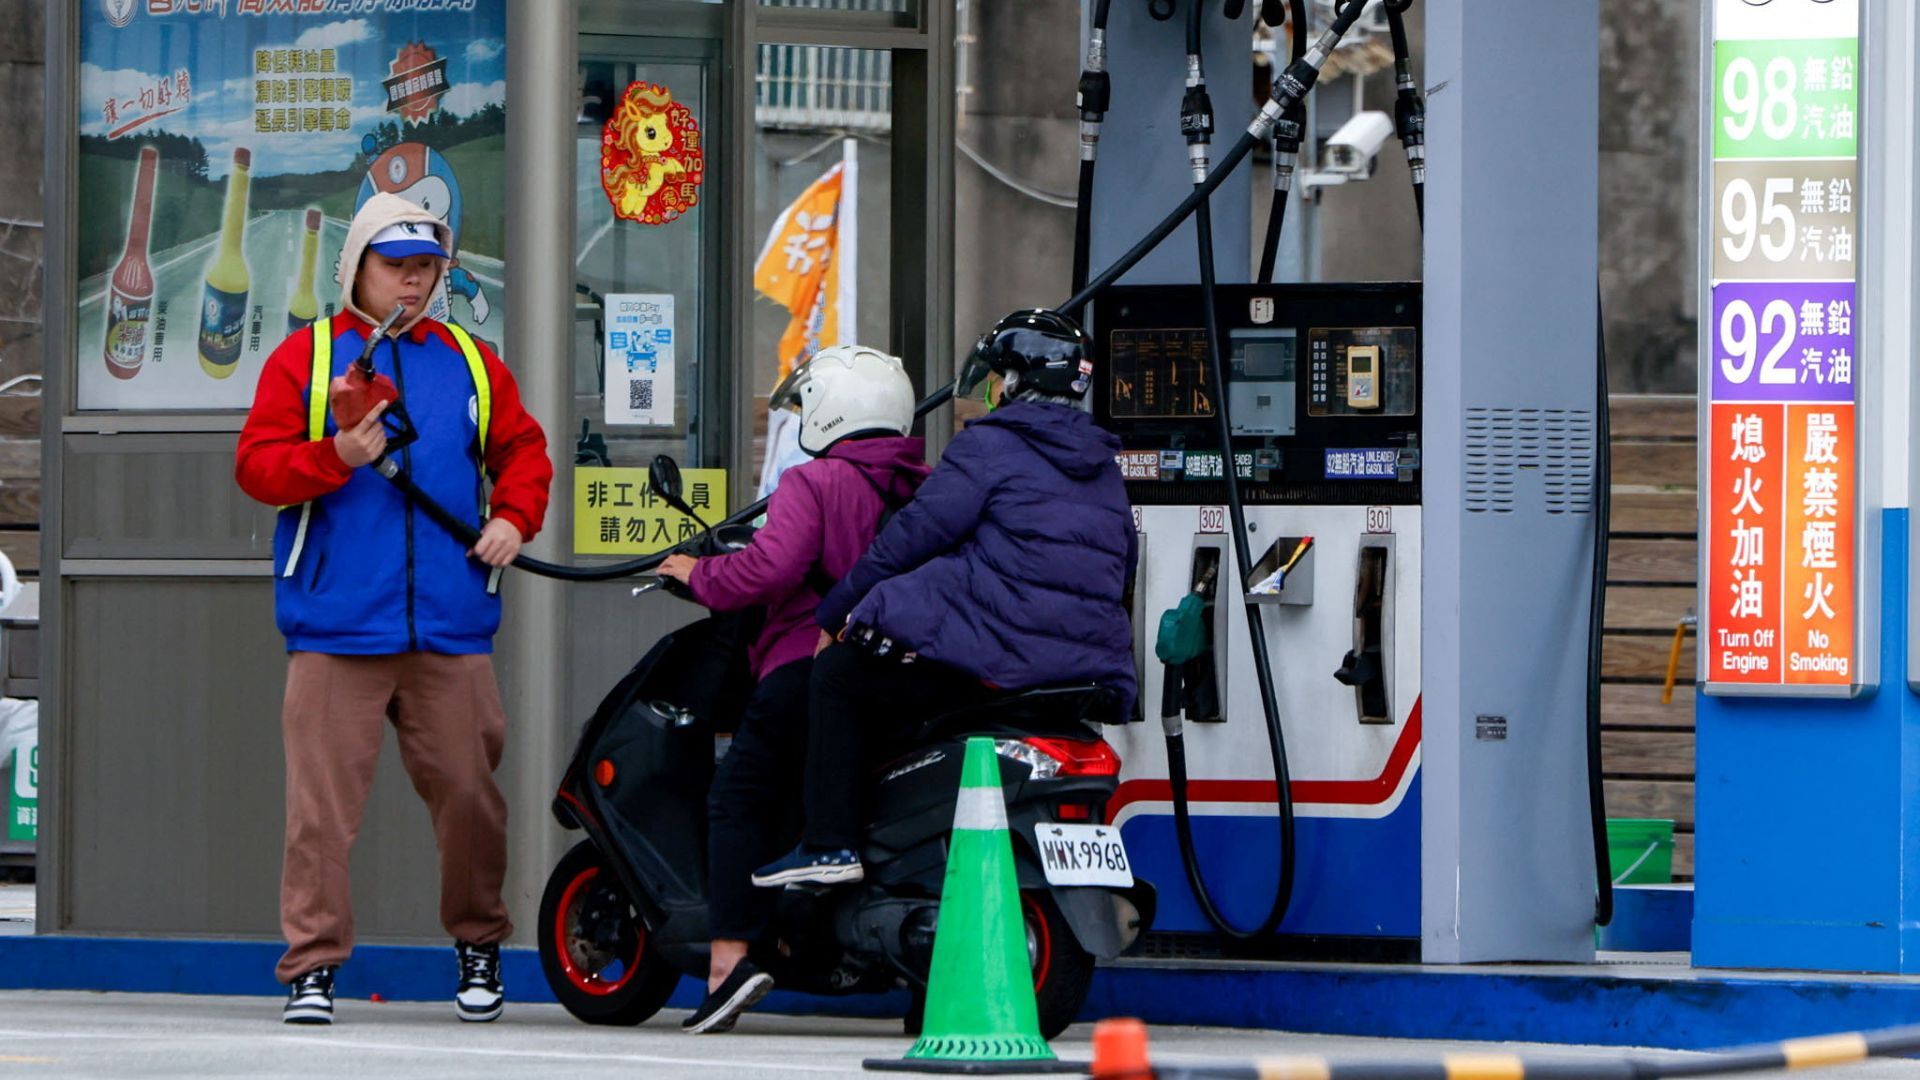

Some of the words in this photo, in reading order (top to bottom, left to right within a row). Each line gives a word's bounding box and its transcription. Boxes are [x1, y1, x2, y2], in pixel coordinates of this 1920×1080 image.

[255, 49, 336, 74] 降低耗油量
[255, 78, 352, 104] 清除引擎積碳
[1722, 57, 1798, 141] 98
[1802, 56, 1853, 92] 無鉛
[255, 107, 352, 133] 延長引擎壽命
[1801, 104, 1854, 140] 汽油
[670, 108, 703, 204] 好運加馬
[1721, 177, 1796, 263] 95
[1800, 178, 1852, 214] 無鉛
[1800, 226, 1852, 262] 汽油
[427, 296, 446, 317] UBE
[1254, 299, 1270, 320] F1
[1720, 299, 1797, 385] 92
[1800, 299, 1851, 336] 無鉛
[1800, 347, 1852, 385] 汽油
[821, 416, 844, 434] YAMAHA
[1130, 454, 1158, 465] UNLEADED
[1130, 465, 1158, 478] GASOLINE
[1186, 455, 1224, 478] 98無鉛汽油
[1327, 453, 1365, 476] 92無鉛汽油
[1366, 451, 1395, 463] UNLEADED
[1366, 463, 1395, 475] GASOLINE
[587, 481, 710, 509] 非工作員
[1202, 510, 1222, 529] 302
[1369, 510, 1389, 529] 301
[1730, 412, 1766, 619] 熄火加油
[1802, 412, 1839, 620] 嚴禁煙火
[600, 517, 697, 543] 請勿入內
[1718, 629, 1749, 648] Turn
[1753, 629, 1774, 648] Off
[1808, 630, 1829, 648] No
[1722, 653, 1769, 674] Engine
[1790, 654, 1848, 676] Smoking
